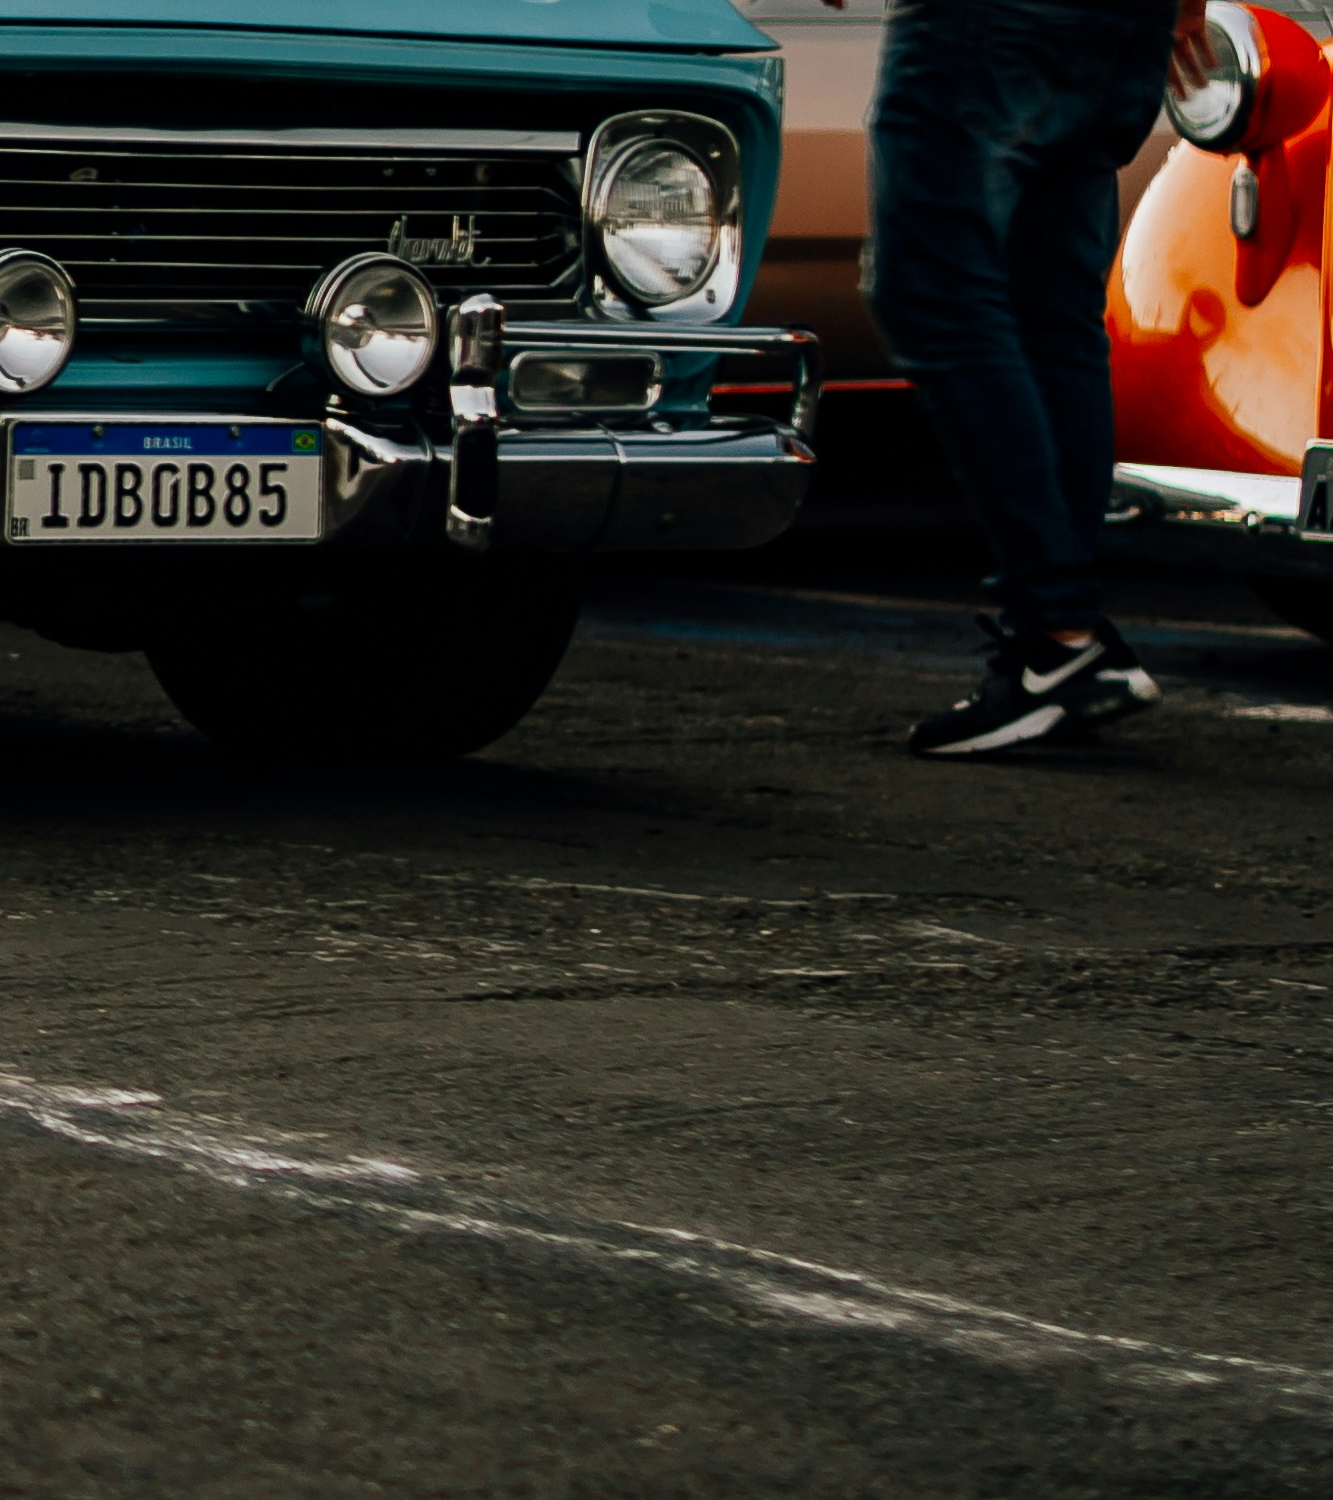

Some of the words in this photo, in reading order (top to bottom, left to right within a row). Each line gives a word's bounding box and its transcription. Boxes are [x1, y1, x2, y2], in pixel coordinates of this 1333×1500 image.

[143, 436, 193, 449] BRASIL
[41, 462, 289, 528] IDB0B85
[10, 517, 30, 537] BR
